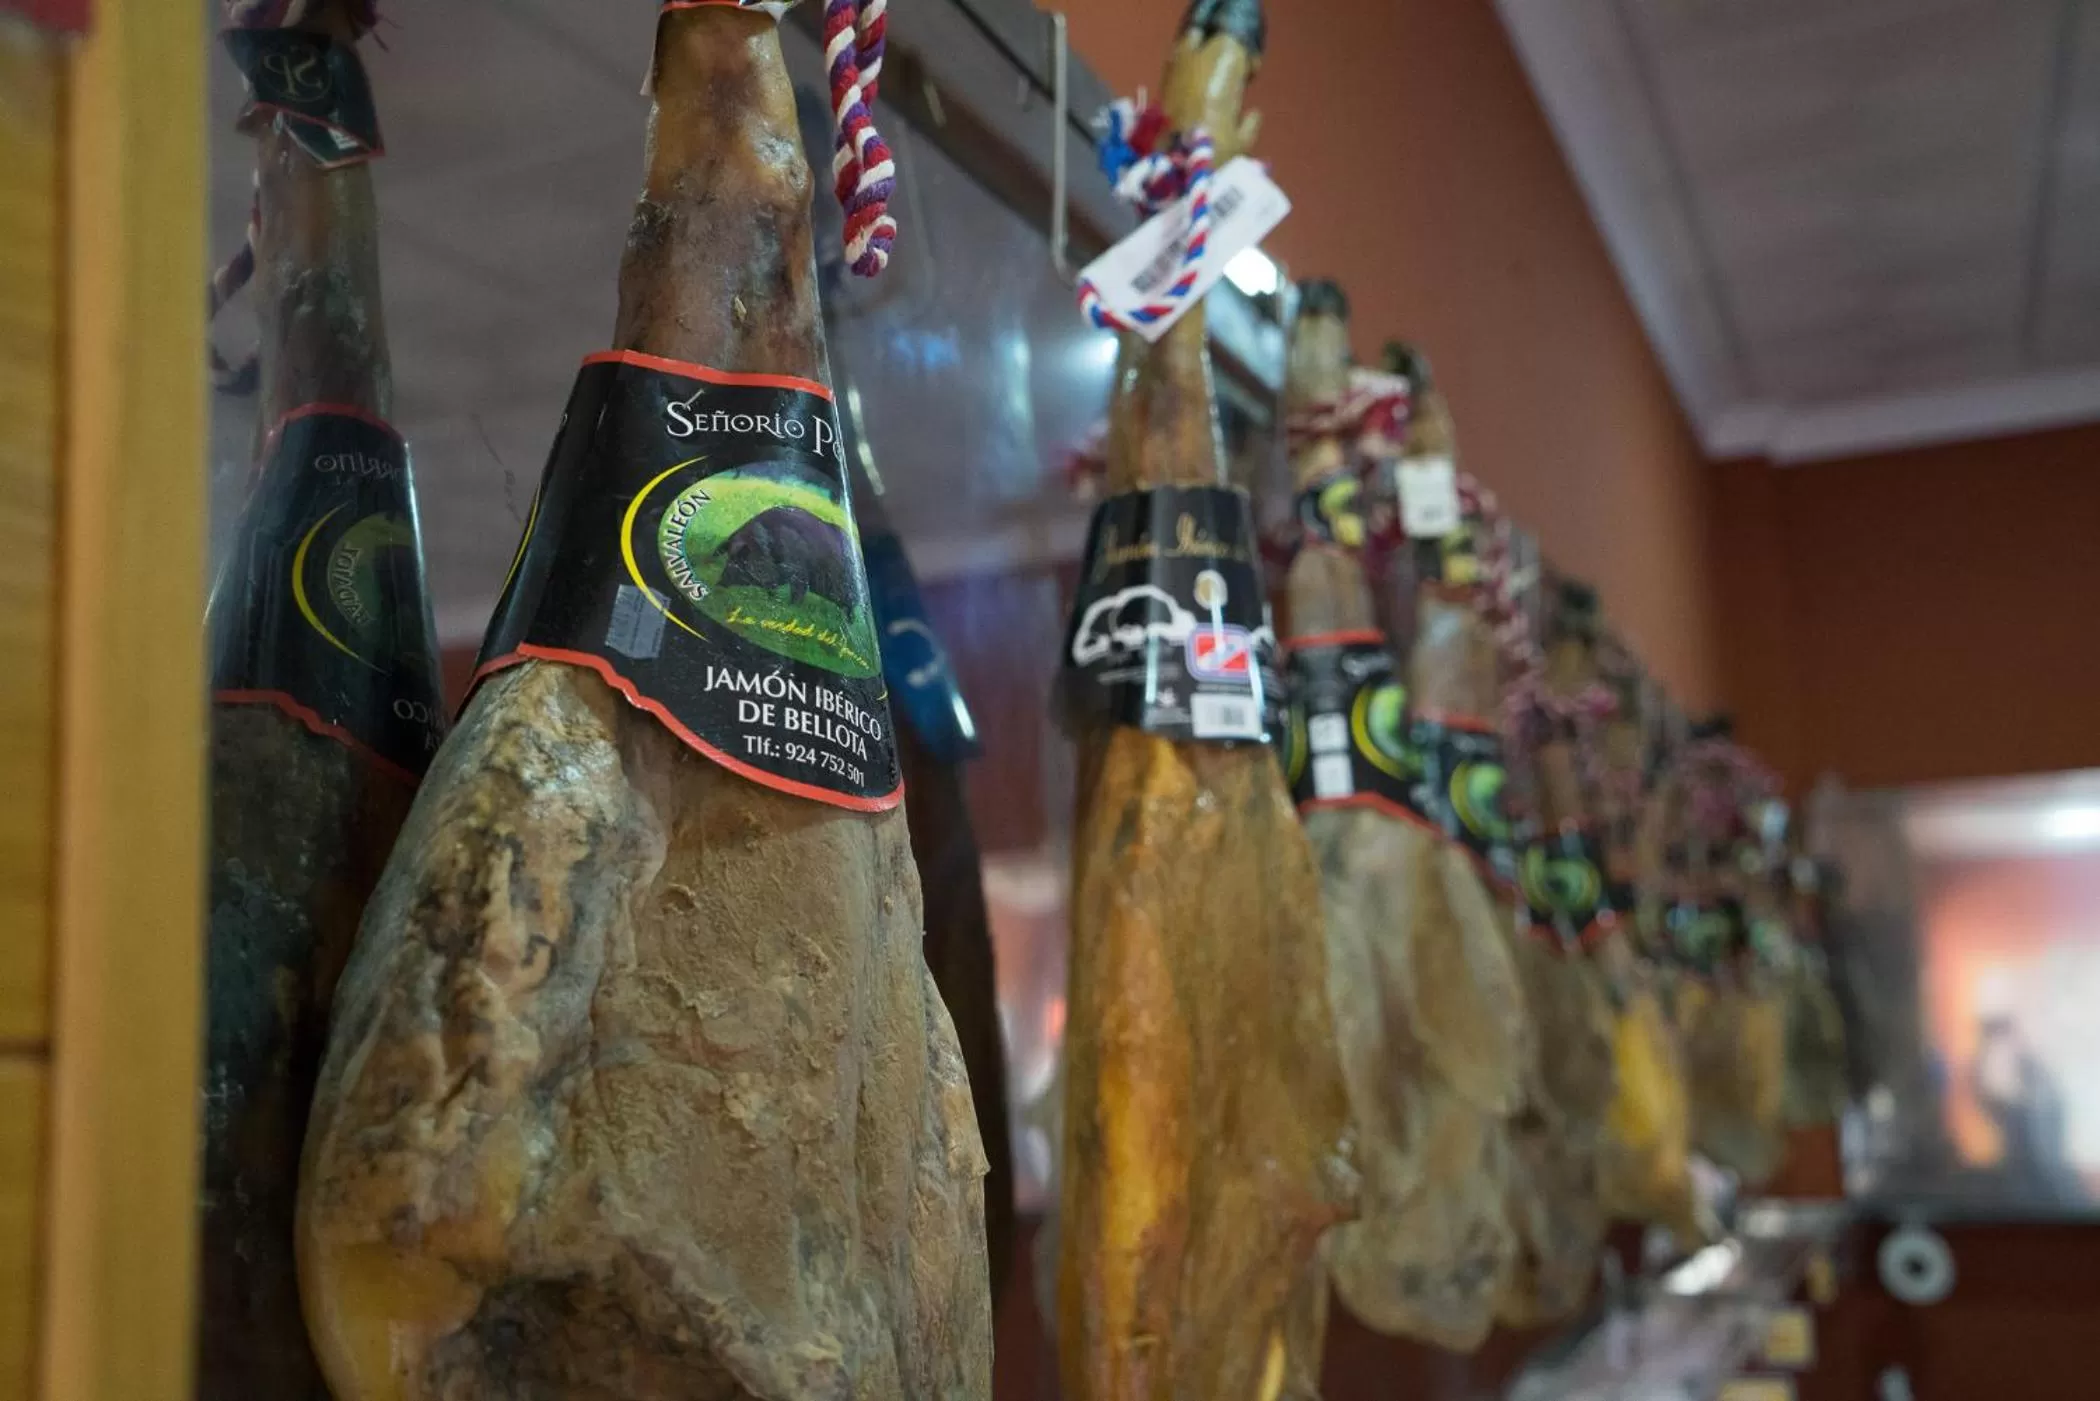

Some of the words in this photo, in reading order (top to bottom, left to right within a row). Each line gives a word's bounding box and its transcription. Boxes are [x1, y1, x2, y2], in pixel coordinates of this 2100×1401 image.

[667, 488, 711, 601] SALVALEÓN
[704, 666, 807, 704] JAMÓN
[815, 685, 882, 741] IBÉRICO
[738, 700, 776, 726] DE
[784, 707, 868, 761] BELLOTA
[785, 742, 817, 765] 924
[820, 751, 845, 775] 752
[848, 764, 865, 788] 501
